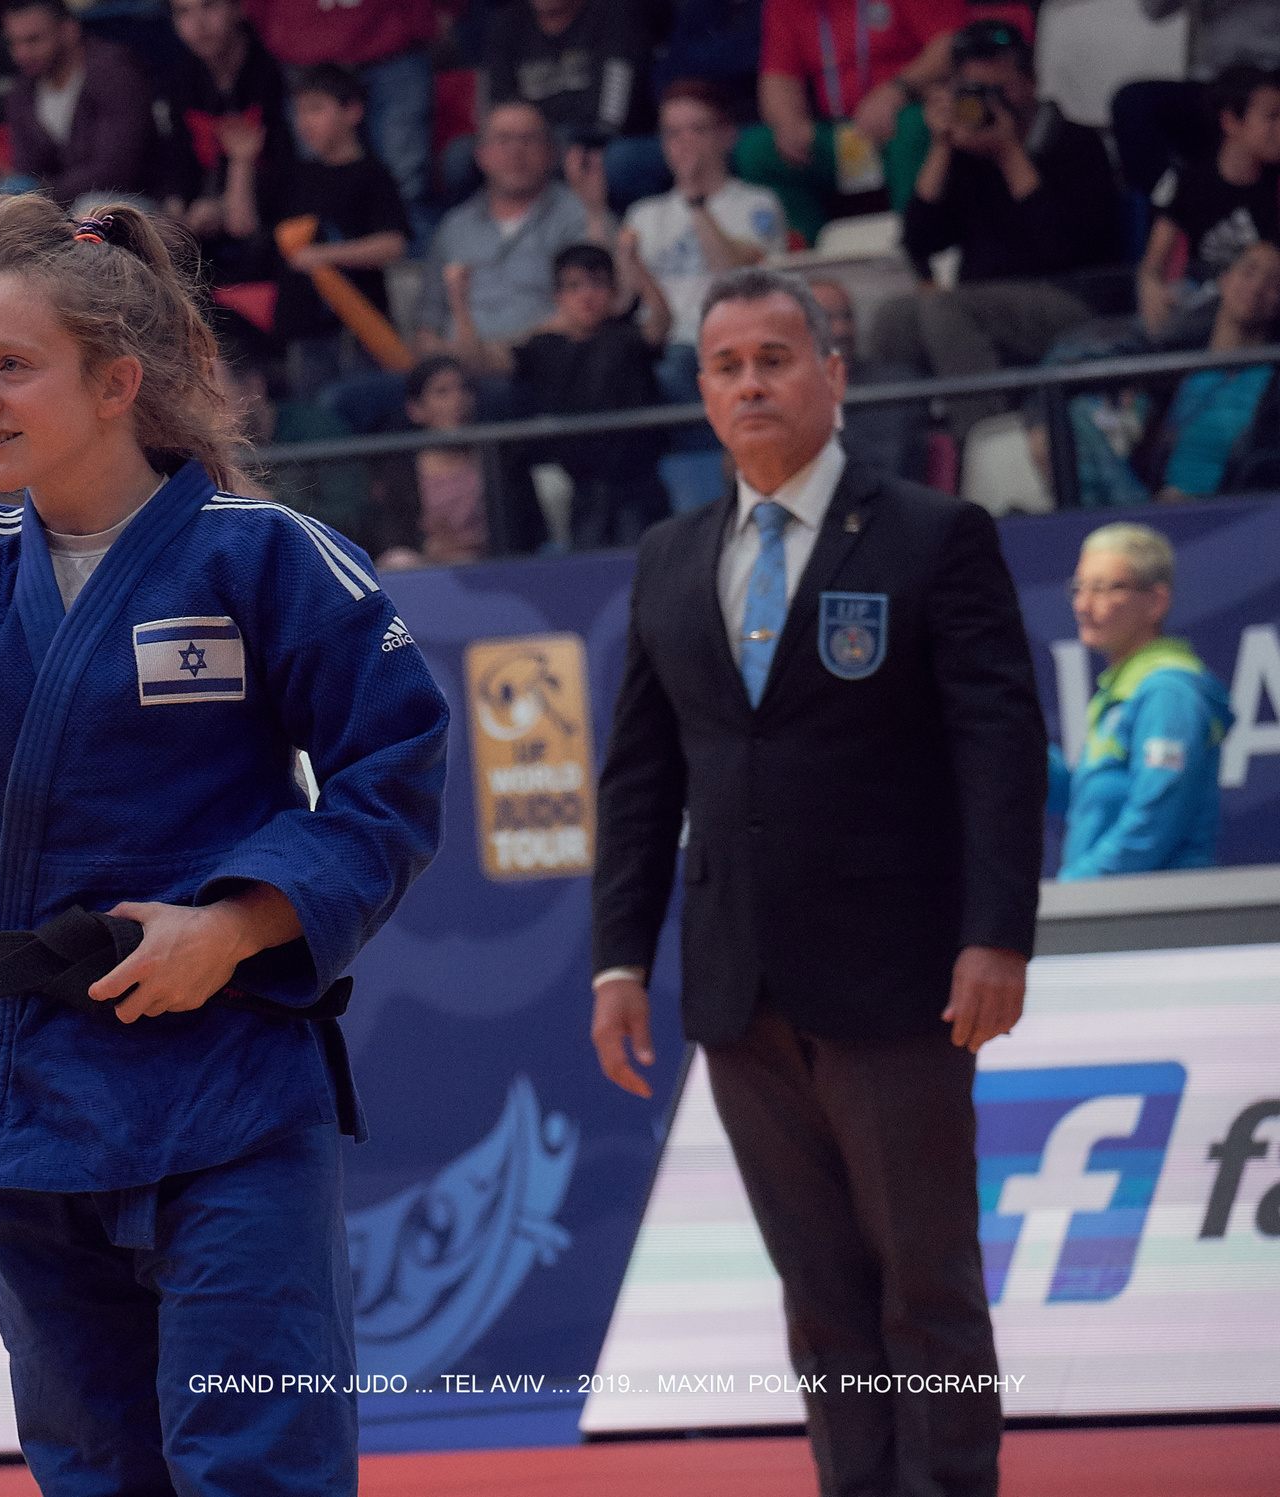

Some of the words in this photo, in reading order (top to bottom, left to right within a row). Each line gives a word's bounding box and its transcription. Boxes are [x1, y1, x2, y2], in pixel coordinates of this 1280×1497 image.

[488, 763, 583, 793] WORLD
[494, 794, 585, 830] JUDO
[492, 827, 589, 869] TOUR
